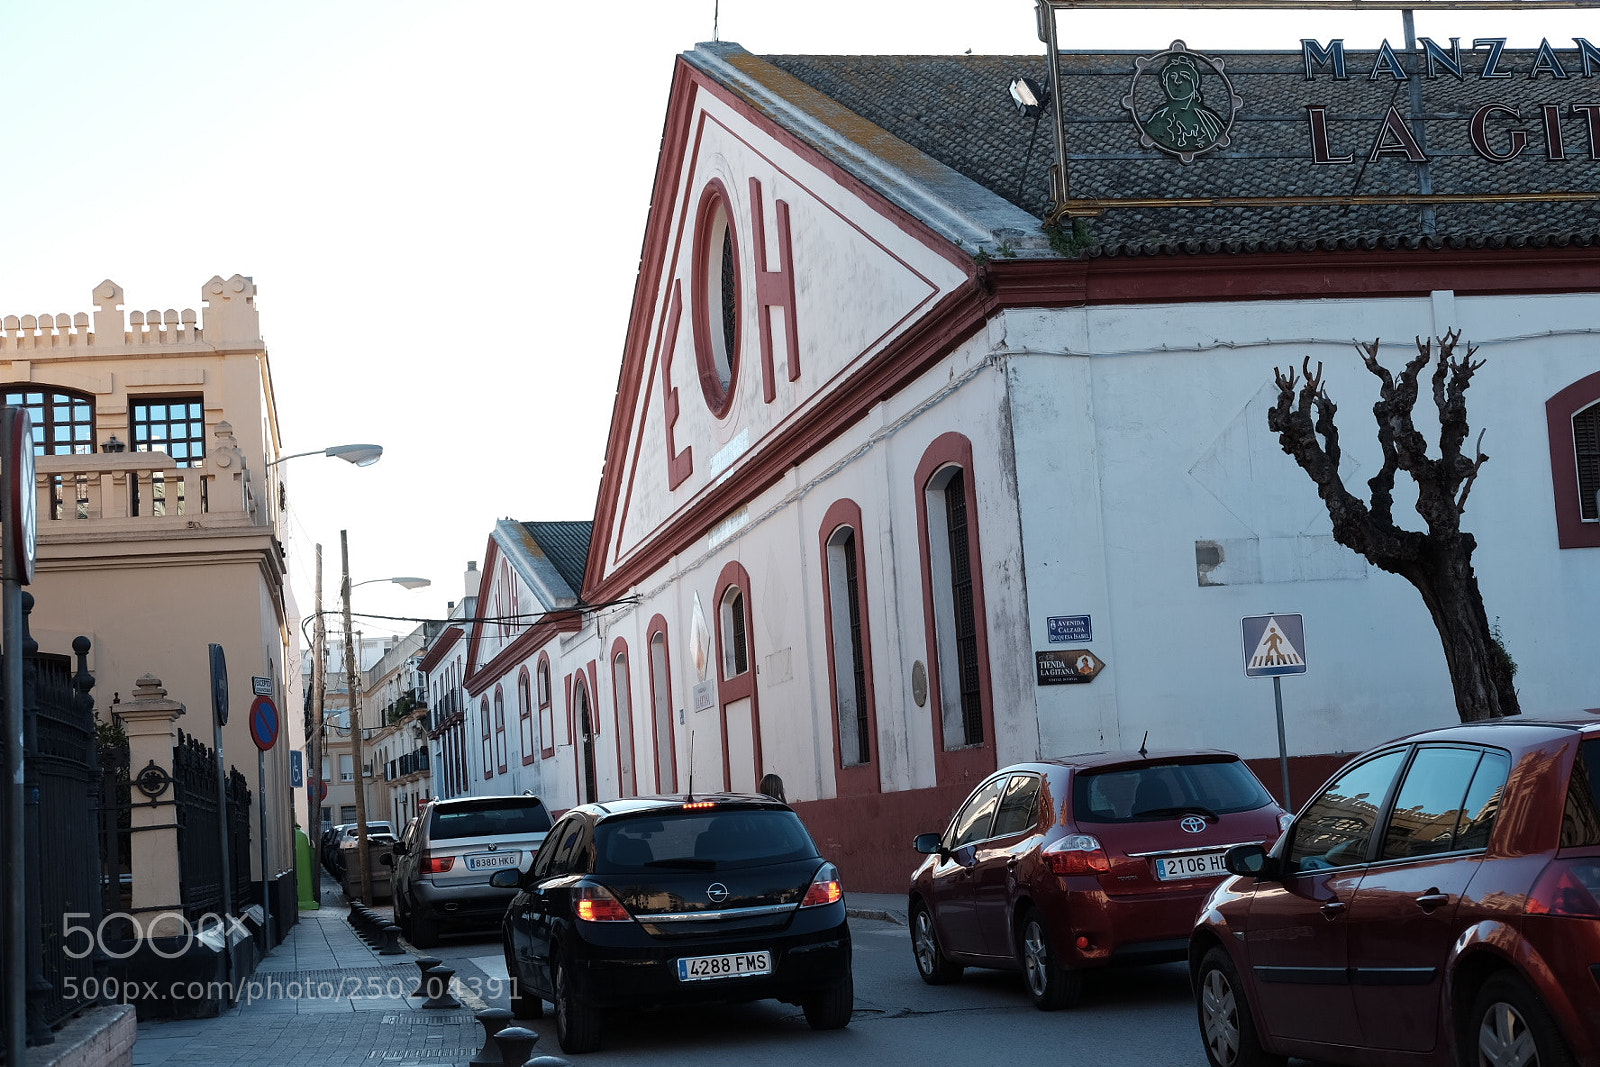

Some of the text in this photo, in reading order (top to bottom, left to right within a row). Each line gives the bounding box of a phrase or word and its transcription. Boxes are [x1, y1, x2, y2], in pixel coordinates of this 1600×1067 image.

[1306, 103, 1430, 165] LA
[1039, 660, 1066, 669] TIENDA
[1050, 668, 1075, 676] GITANA
[475, 856, 515, 868] 8380 HKG
[1167, 855, 1226, 875] 2106 HD
[690, 954, 767, 976] 4288 FMS
